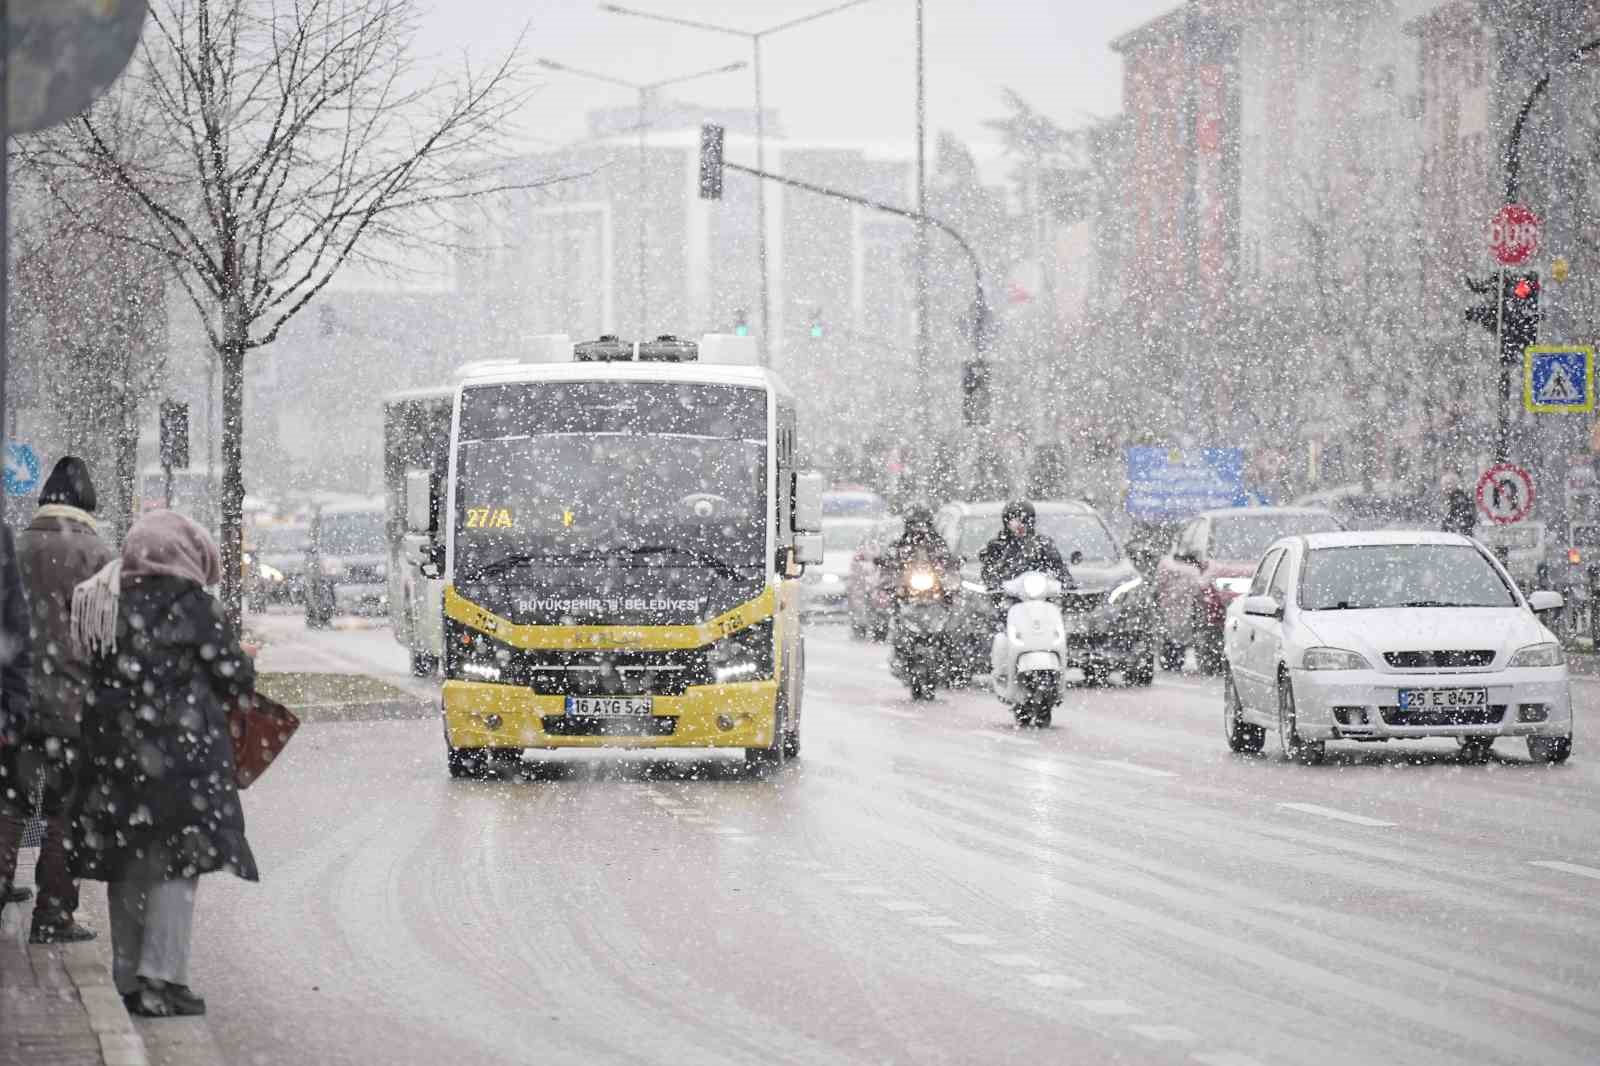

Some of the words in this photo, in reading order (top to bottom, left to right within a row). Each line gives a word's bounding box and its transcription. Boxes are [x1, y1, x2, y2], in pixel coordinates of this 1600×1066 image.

[1489, 223, 1537, 246] DUR
[466, 508, 513, 529] 27/A
[519, 597, 601, 612] BÜYÜKŞEHİR
[624, 597, 699, 611] BELEDİYESİ
[575, 699, 589, 714] 16
[593, 699, 621, 714] AYG
[624, 699, 650, 714] 529
[1432, 692, 1444, 706] E
